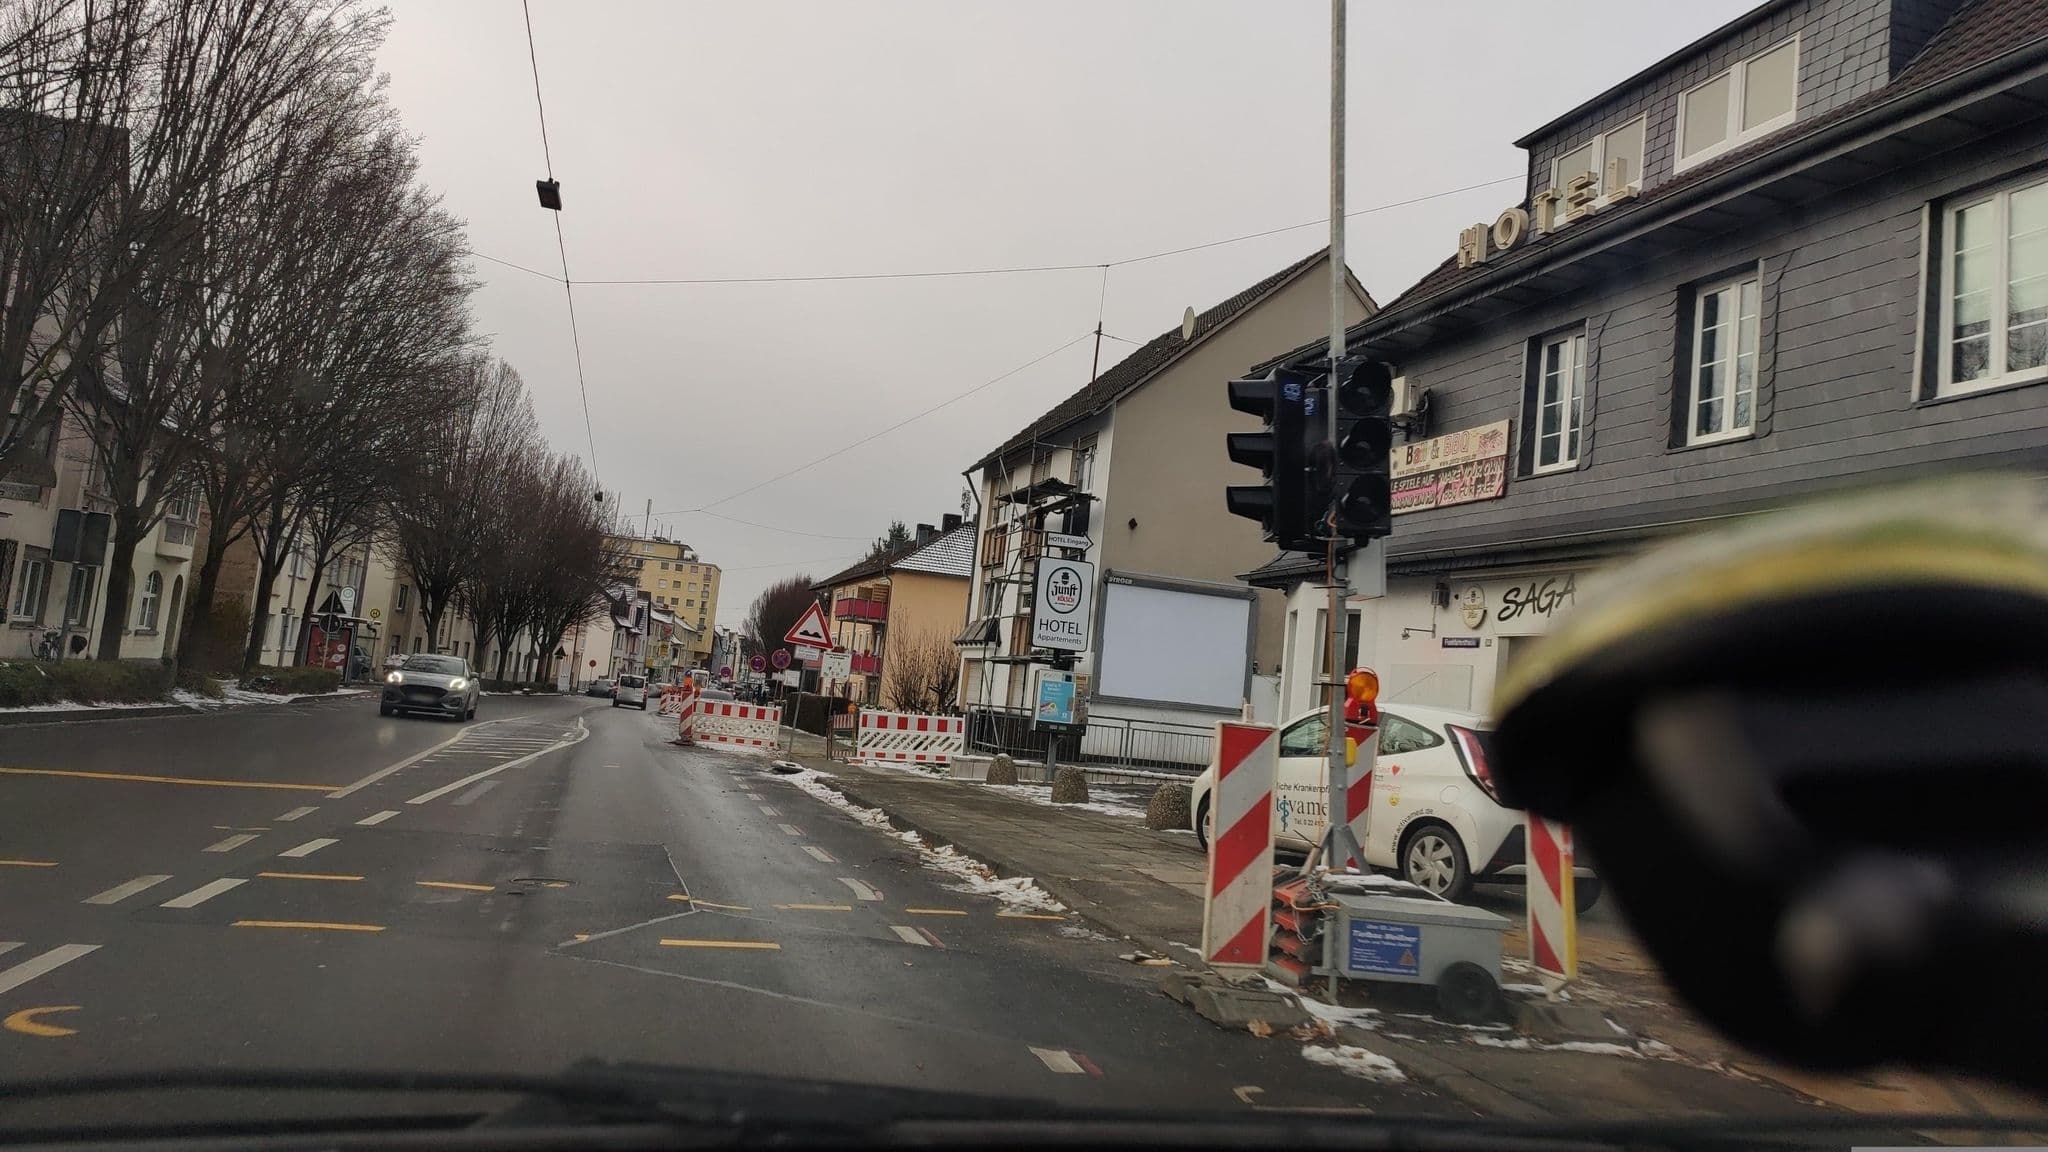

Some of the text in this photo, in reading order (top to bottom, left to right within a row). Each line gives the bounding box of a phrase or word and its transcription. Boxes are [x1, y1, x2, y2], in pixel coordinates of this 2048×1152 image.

[1458, 156, 1639, 270] HOTEL
[1443, 431, 1469, 456] BBQ
[1048, 536, 1089, 547] HOTEL Eingang
[1497, 573, 1576, 622] SAGA
[1039, 618, 1083, 636] HOTEL
[1037, 633, 1083, 645] Appartements
[1276, 795, 1328, 818] tivame
